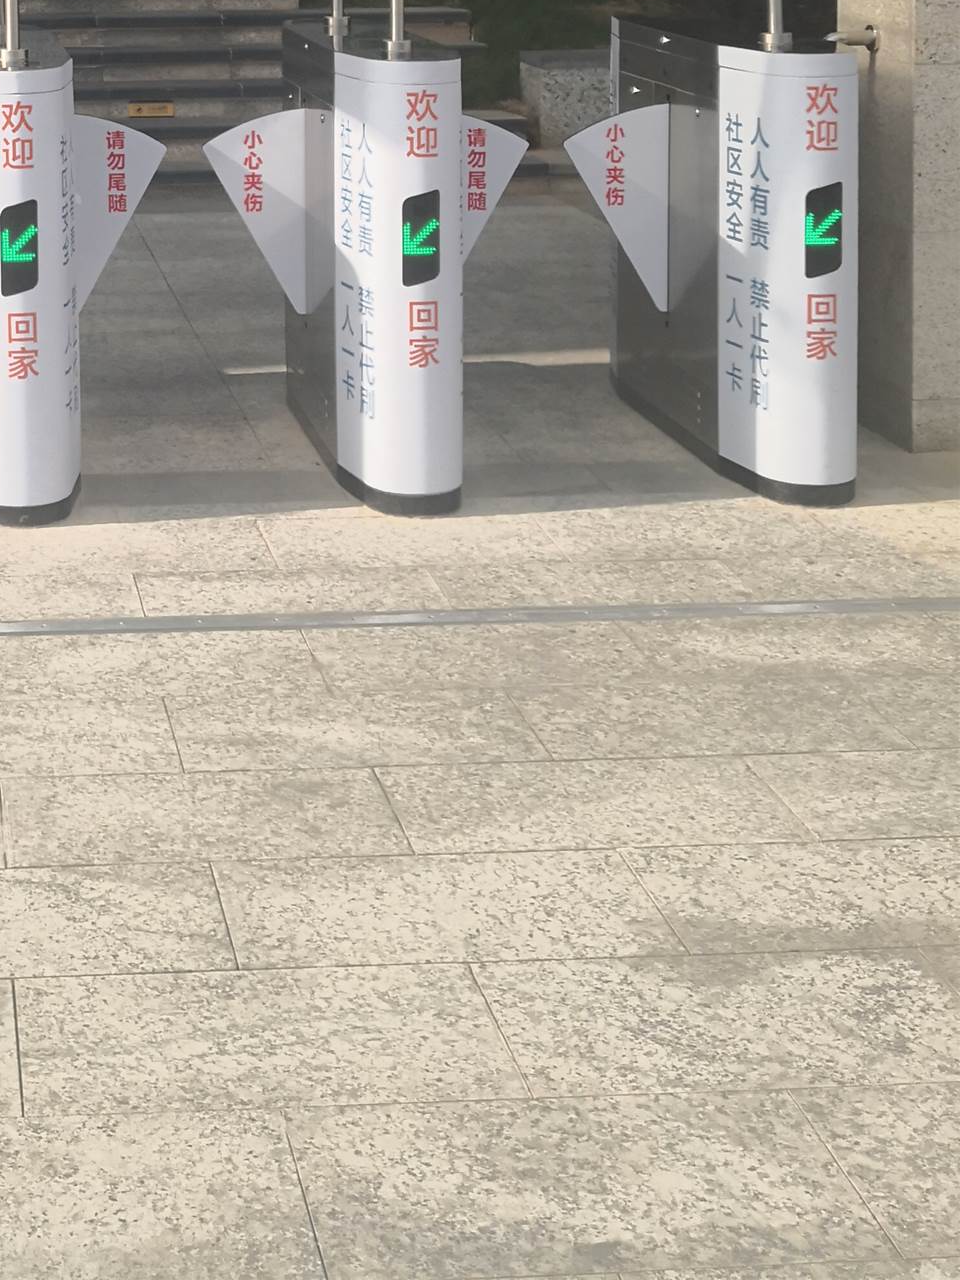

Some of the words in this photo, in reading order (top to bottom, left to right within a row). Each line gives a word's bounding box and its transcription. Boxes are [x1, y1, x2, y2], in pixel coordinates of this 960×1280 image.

[0, 101, 33, 170] 欢迎
[406, 91, 438, 159] 欢迎
[805, 85, 838, 152] 欢迎
[106, 131, 127, 213] 请勿尾随
[243, 130, 263, 213] 小心夹伤
[467, 128, 486, 211] 请勿尾随
[605, 123, 625, 207] 小心夹伤
[726, 112, 743, 242] 社区安全
[750, 117, 769, 250] 人人有责
[6, 311, 39, 380] 回家
[407, 300, 439, 369] 回家
[726, 274, 743, 392] 一人一卡
[805, 292, 837, 360] 回家
